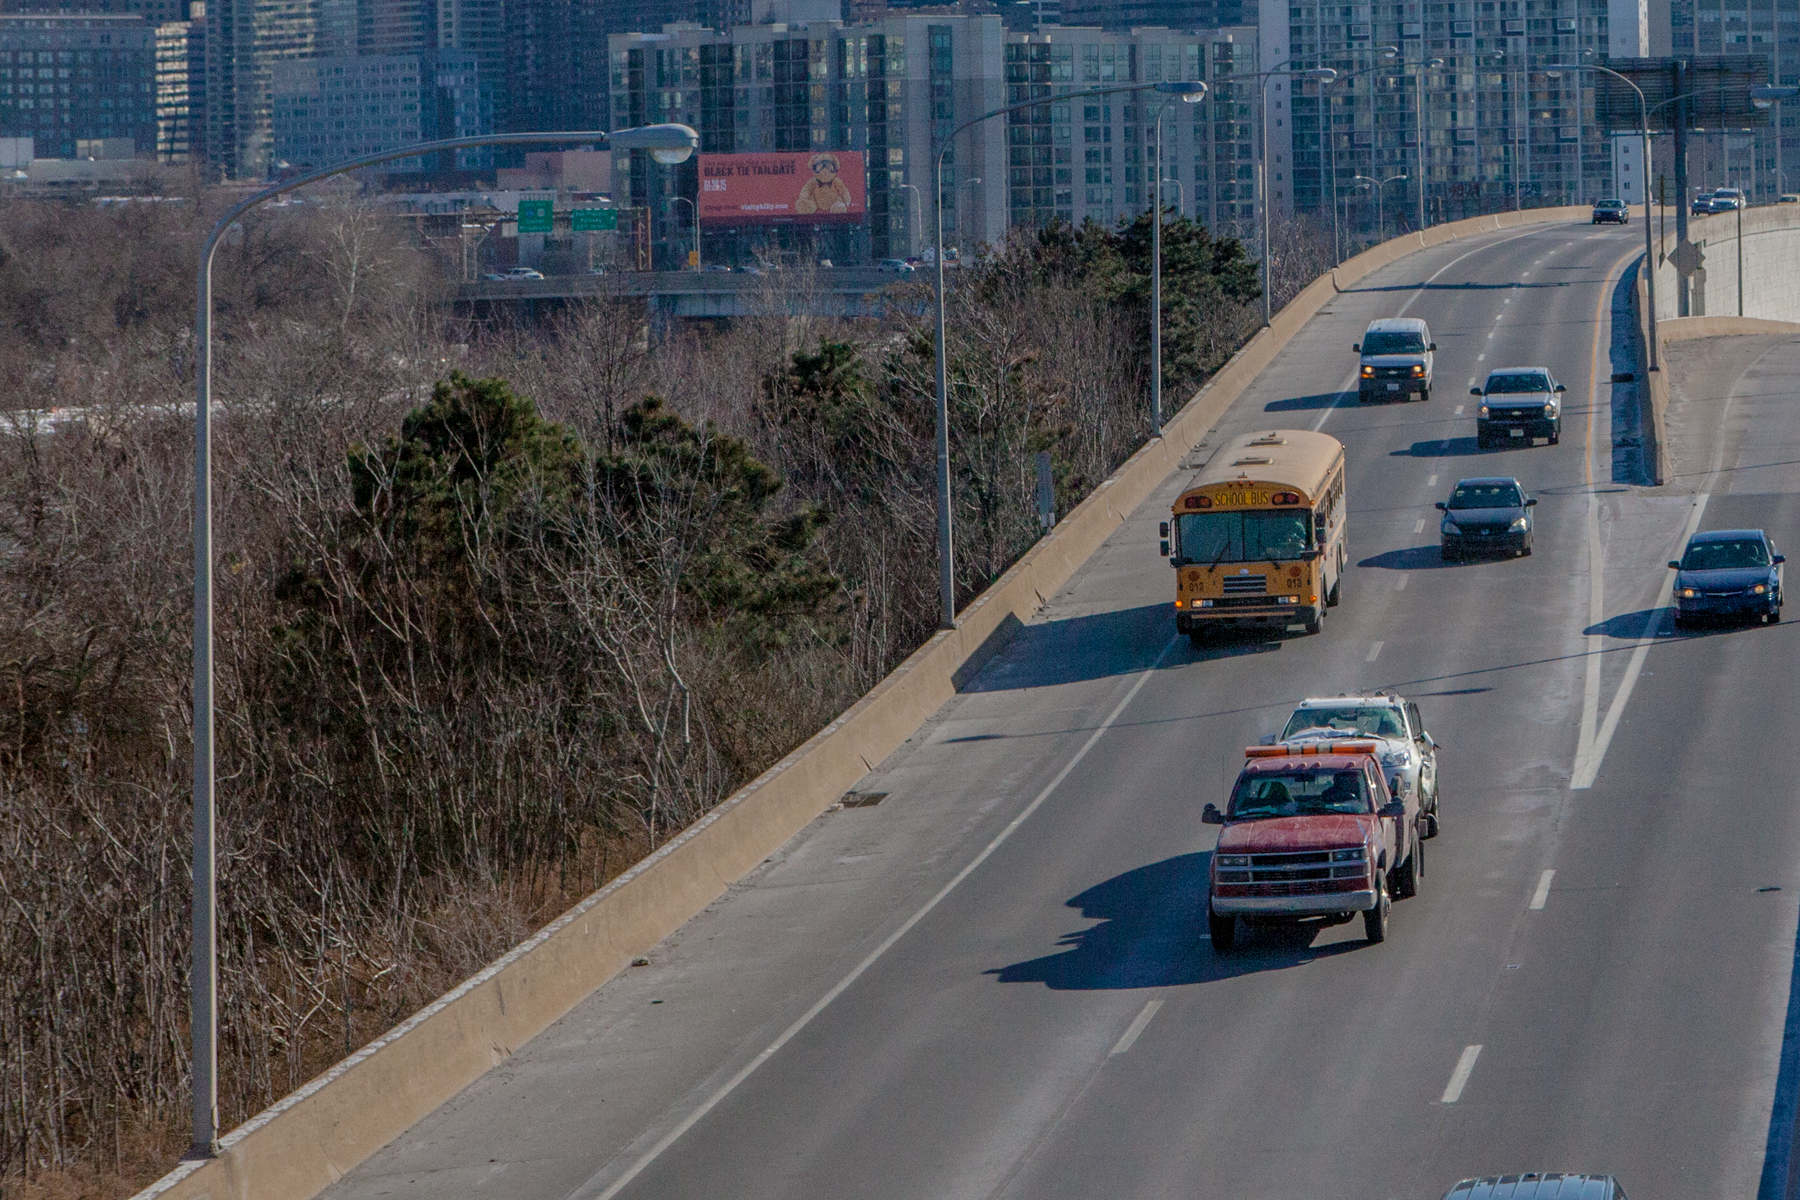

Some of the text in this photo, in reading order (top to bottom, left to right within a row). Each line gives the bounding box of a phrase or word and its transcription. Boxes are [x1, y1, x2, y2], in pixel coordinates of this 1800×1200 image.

[704, 164, 796, 177] BLACK TIE TAILGATE
[1215, 491, 1269, 506] SCHOOL BUS
